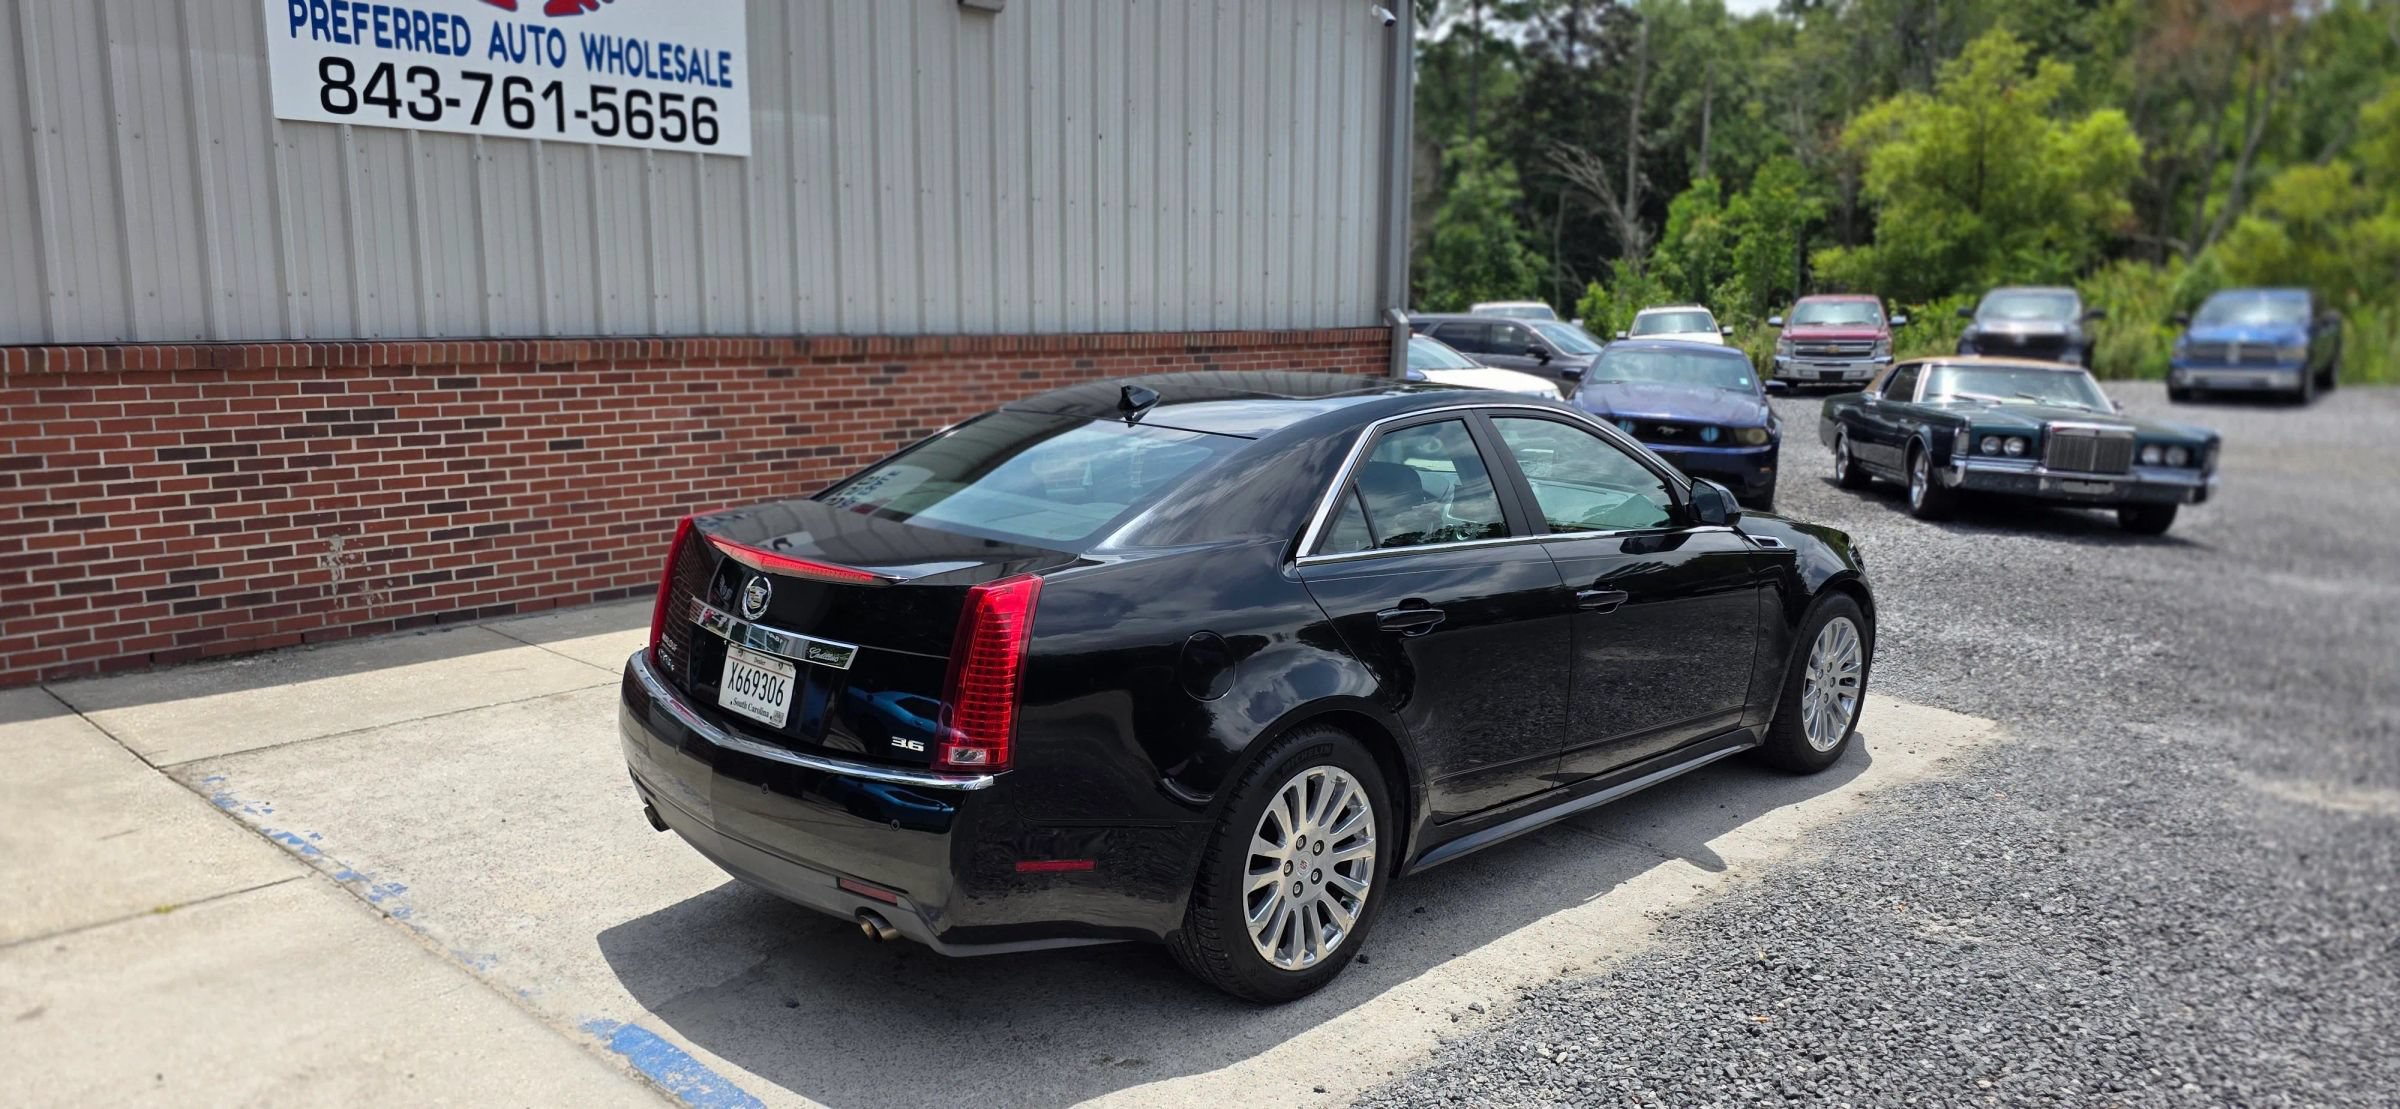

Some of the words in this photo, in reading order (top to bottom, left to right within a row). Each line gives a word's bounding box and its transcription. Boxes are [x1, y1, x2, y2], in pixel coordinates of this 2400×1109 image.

[288, 0, 472, 57] PREFERRED
[487, 20, 567, 69] AUTO
[581, 31, 733, 89] WHOLESALE
[318, 56, 720, 146] 843-761-5656
[727, 661, 786, 707] X669306
[732, 696, 748, 710] South
[747, 702, 770, 719] Carolina
